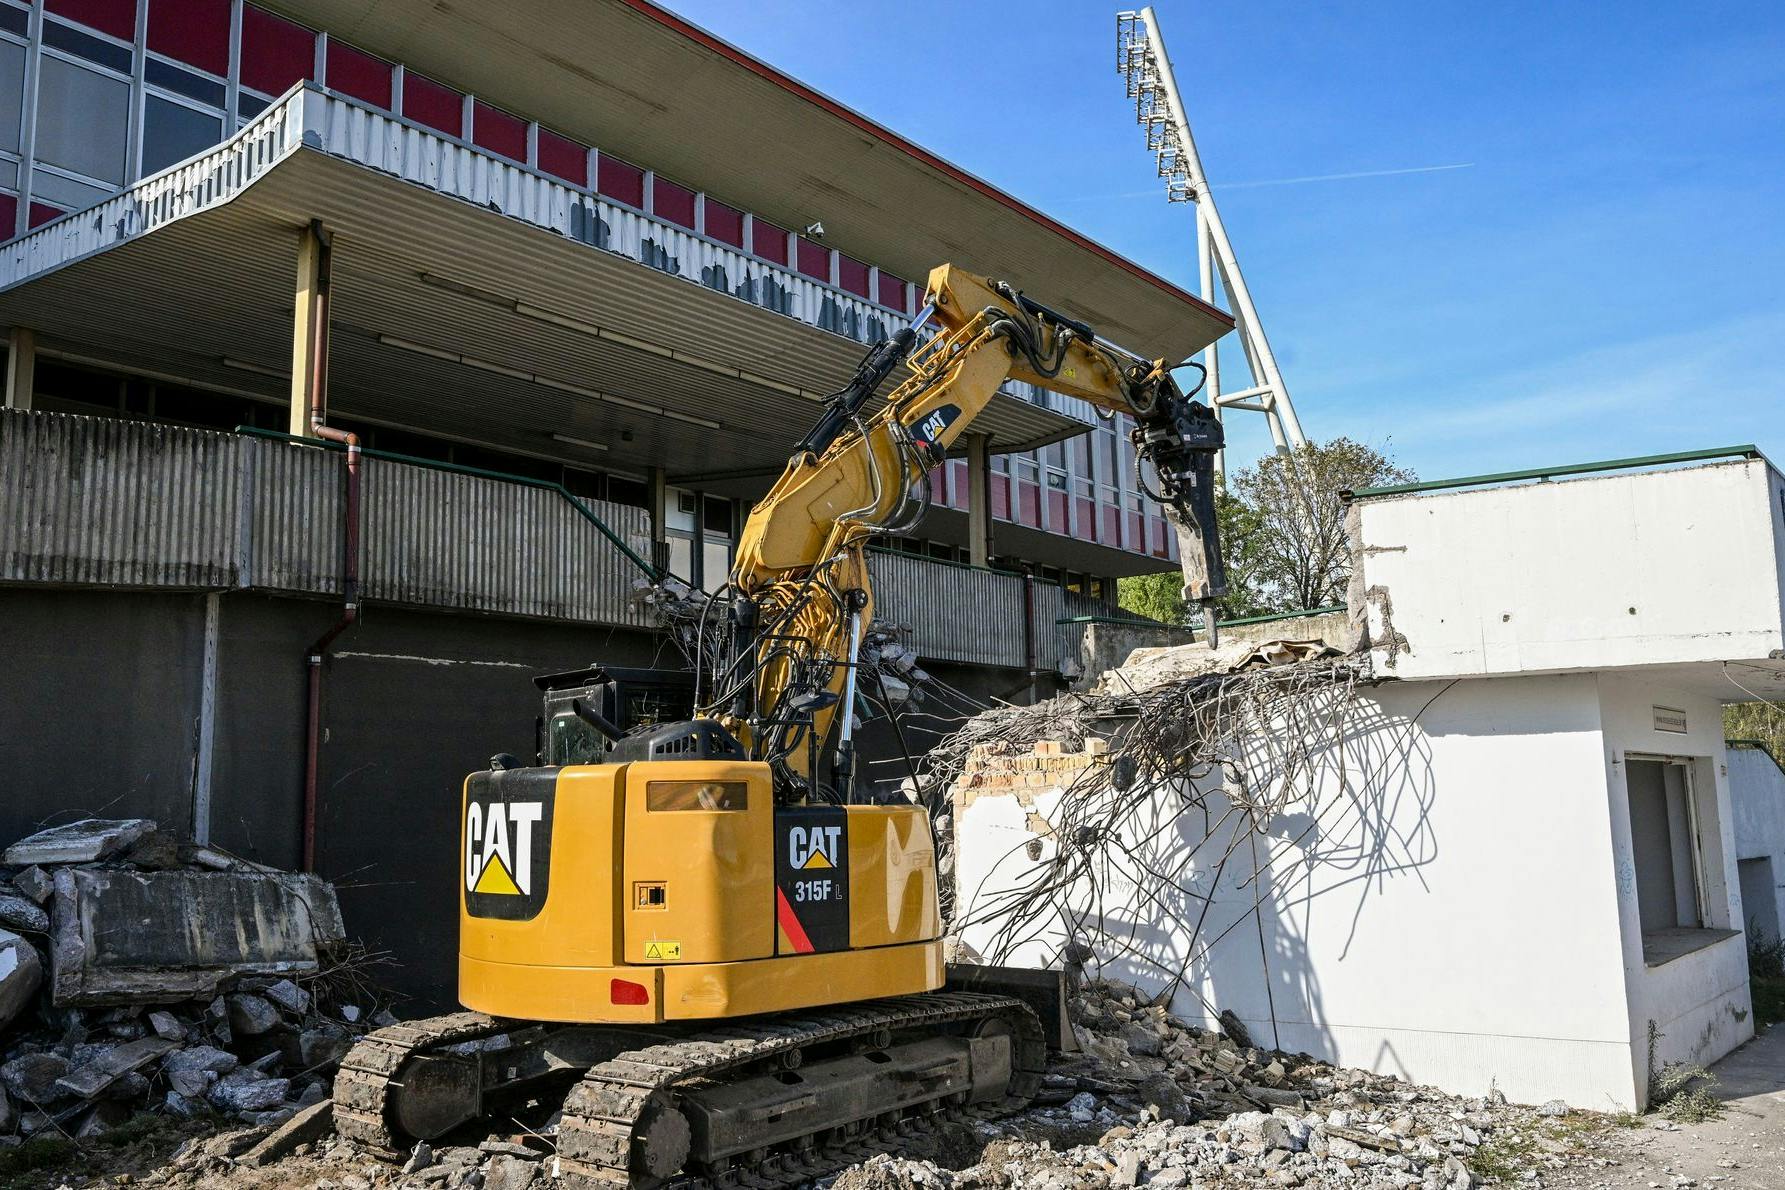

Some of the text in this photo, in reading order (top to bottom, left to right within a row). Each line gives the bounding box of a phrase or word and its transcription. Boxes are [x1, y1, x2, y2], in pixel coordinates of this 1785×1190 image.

[922, 410, 946, 441] CAT
[466, 801, 542, 895] CAT
[790, 826, 841, 870] CAT
[795, 880, 843, 902] 315F L
